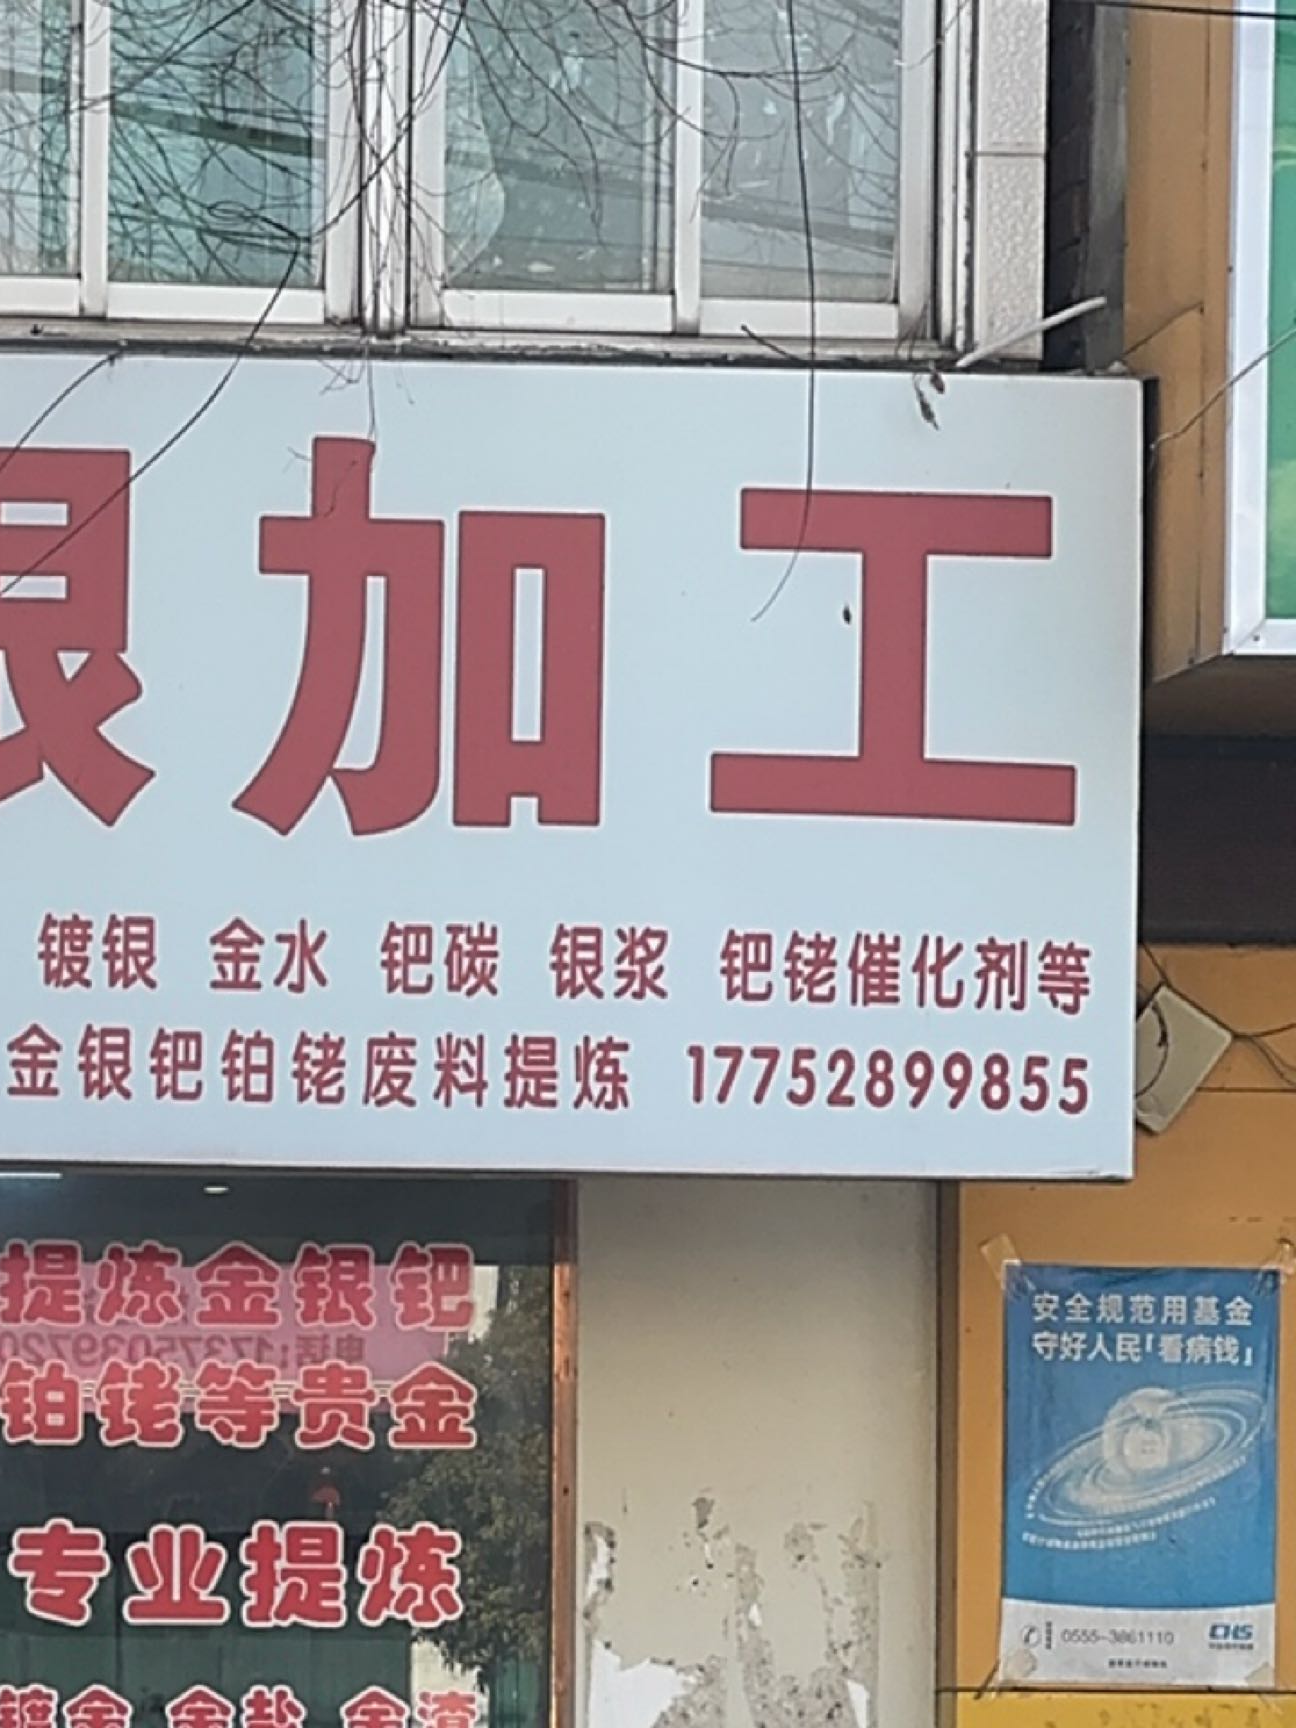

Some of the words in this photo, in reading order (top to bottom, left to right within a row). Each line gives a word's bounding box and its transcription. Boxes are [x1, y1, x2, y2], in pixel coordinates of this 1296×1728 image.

[38, 915, 157, 989] 镀银
[209, 918, 327, 995] 金水
[380, 921, 499, 996] 钯碳
[550, 924, 668, 1000] 银浆
[720, 930, 1091, 1016] 钯铑催化剂等
[688, 1045, 1090, 1114] 17752899855
[1031, 1292, 1254, 1326] 安全规范用基金
[8, 1517, 464, 1628] 专业提炼
